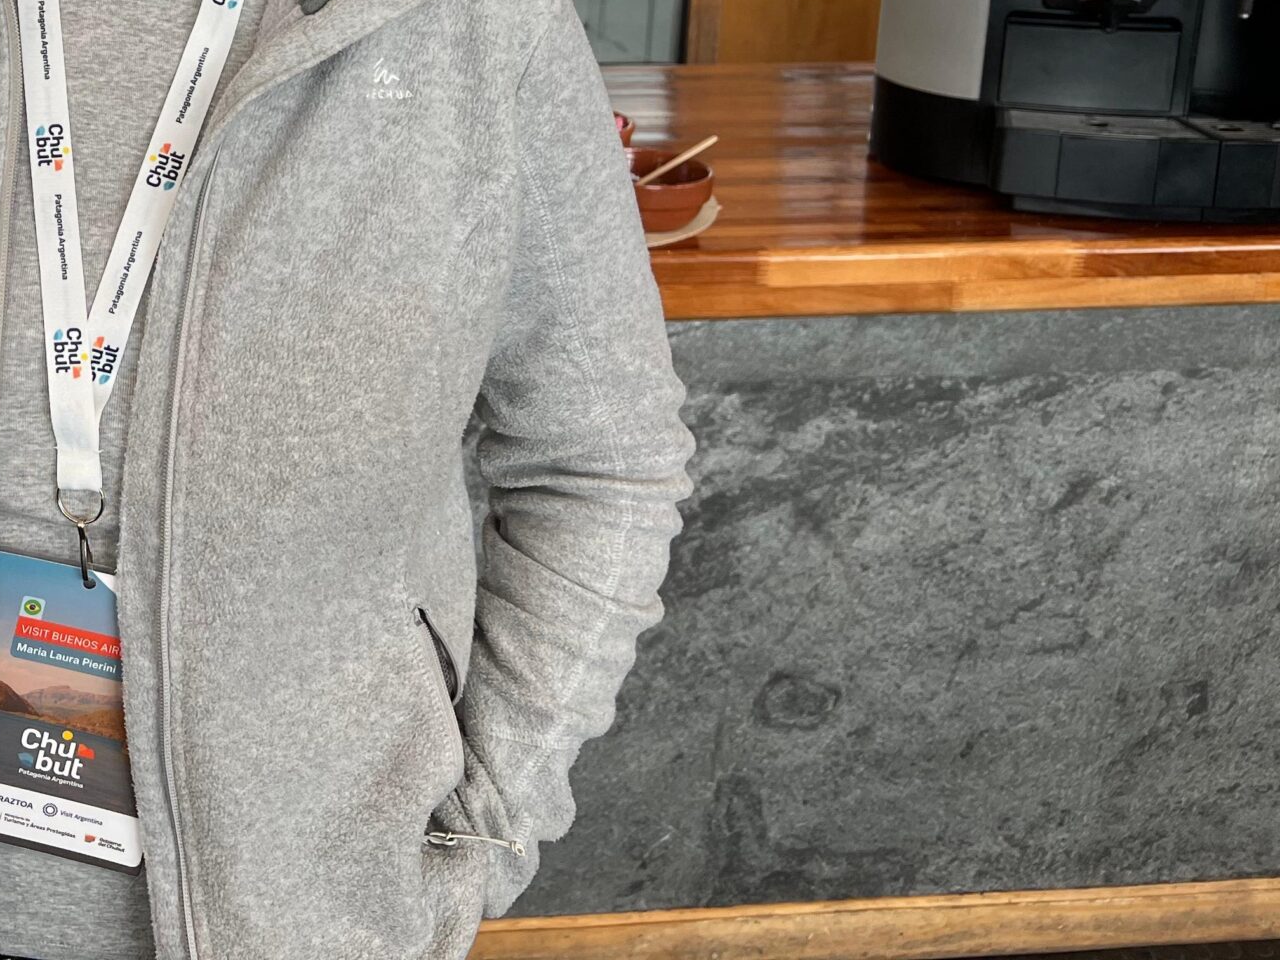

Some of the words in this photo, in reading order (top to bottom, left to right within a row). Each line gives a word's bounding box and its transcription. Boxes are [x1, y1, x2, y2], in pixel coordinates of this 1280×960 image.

[37, 0, 47, 40] Patagonia
[40, 40, 51, 80] Argentina
[175, 85, 195, 124] Patagonia
[190, 46, 210, 86] Argentina
[36, 137, 53, 167] but
[48, 123, 64, 158] Chu
[146, 152, 170, 188] Chu
[162, 150, 186, 181] but
[54, 193, 64, 237] Patagonia
[57, 237, 68, 280] Argentina
[108, 271, 129, 315] Patagonia
[123, 230, 143, 273] Argentina
[53, 341, 71, 374] but
[66, 327, 83, 365] Chu
[97, 344, 120, 374] but
[21, 624, 50, 638] VISIT
[51, 631, 98, 650] BUENOS
[100, 644, 121, 656] AIR
[16, 642, 47, 658] Maria
[49, 650, 80, 665] Laura
[82, 657, 117, 674] Pierini
[21, 727, 77, 759] Chu
[18, 767, 51, 781] Patagonia
[51, 775, 84, 789] Argentina
[35, 749, 84, 780] but
[60, 809, 73, 819] Visit
[73, 814, 104, 826] Argentina
